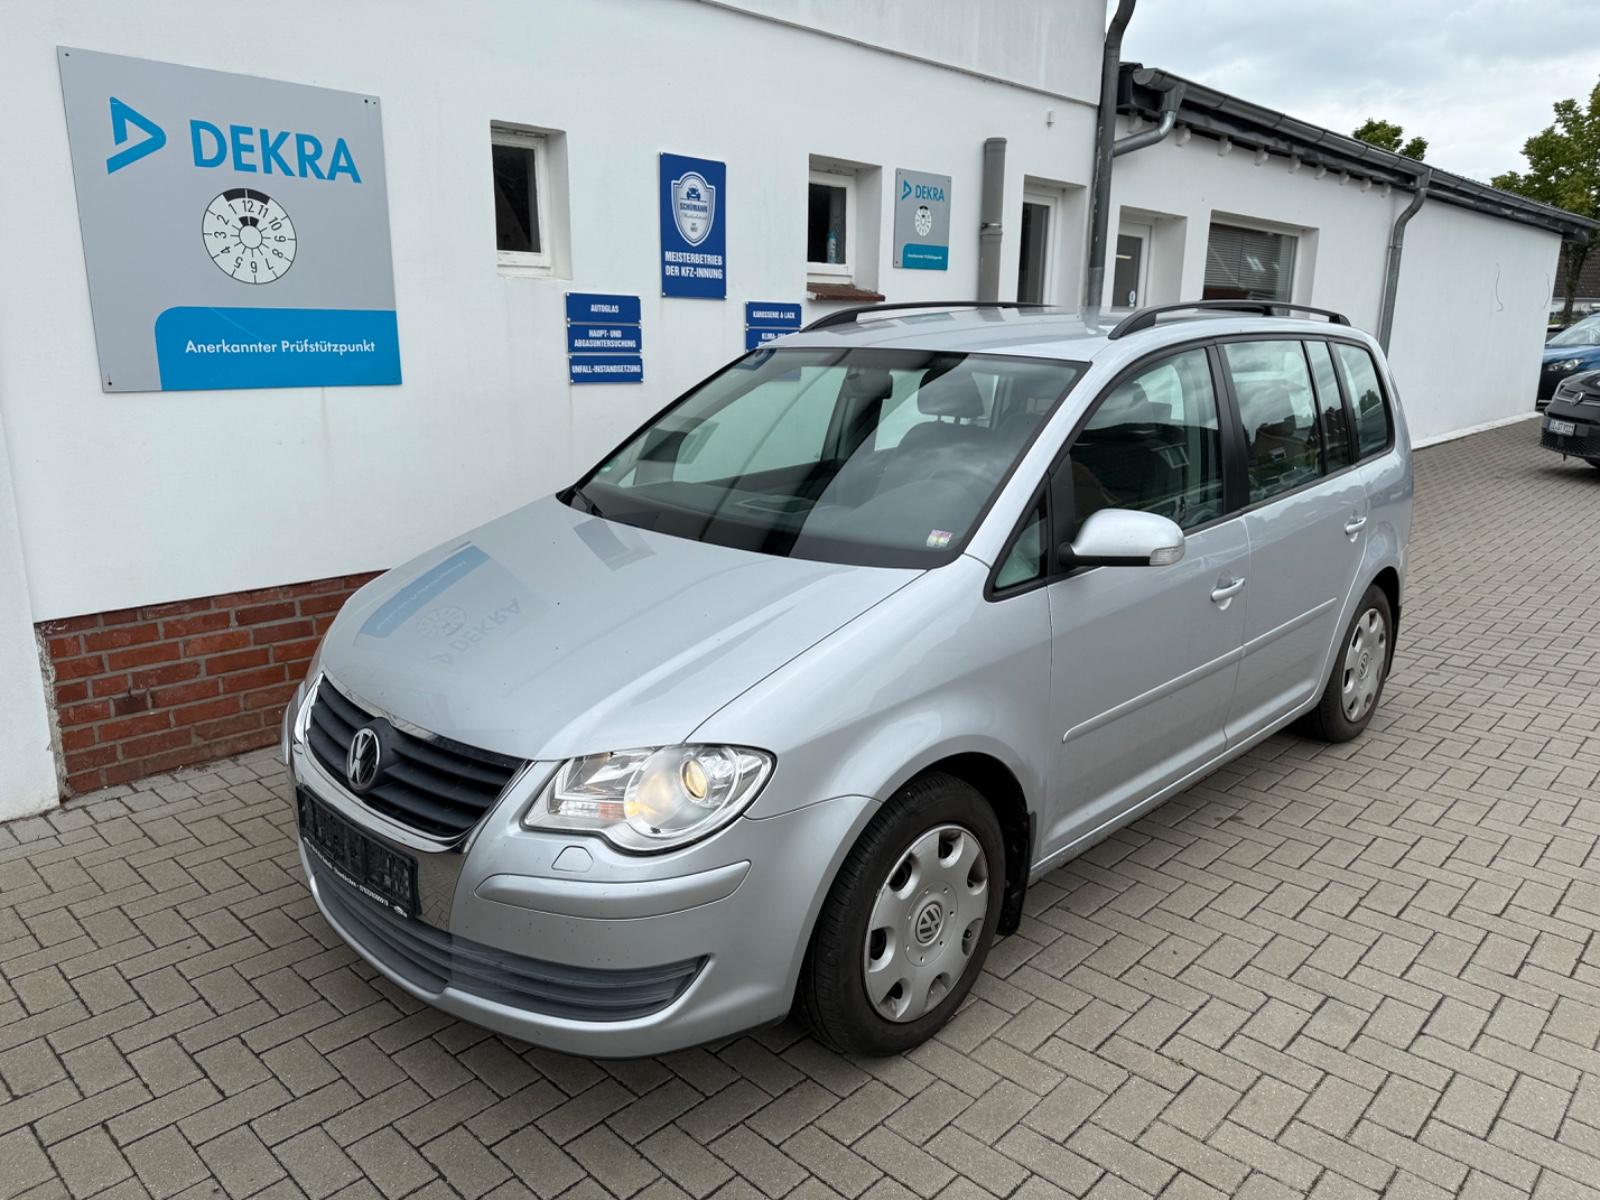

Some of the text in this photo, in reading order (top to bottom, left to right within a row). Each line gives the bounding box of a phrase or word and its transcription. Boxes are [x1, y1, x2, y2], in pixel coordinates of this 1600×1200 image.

[189, 119, 362, 184] DEKRA
[915, 185, 944, 201] DEKRA
[228, 202, 237, 215] 1
[242, 199, 255, 213] 12
[258, 204, 269, 219] 11
[216, 214, 230, 226] 2
[268, 216, 282, 231] 10
[213, 231, 227, 239] 3
[273, 235, 287, 243] 9
[220, 246, 231, 254] 4
[271, 248, 284, 259] 8
[234, 256, 243, 269] 5
[265, 257, 274, 270] 7
[665, 251, 723, 265] MEISTERBETRIEB
[665, 265, 723, 280] DER KFZ-INNUNG
[590, 304, 619, 313] AUTOGLAS
[588, 329, 622, 338] HAUPT- UND
[185, 339, 376, 356] Anerkannter Prüfstützpunkt
[574, 339, 636, 348] ABGASUNTERSUCHUNG
[571, 364, 641, 374] UNFALL-INSTANDSETZUNG
